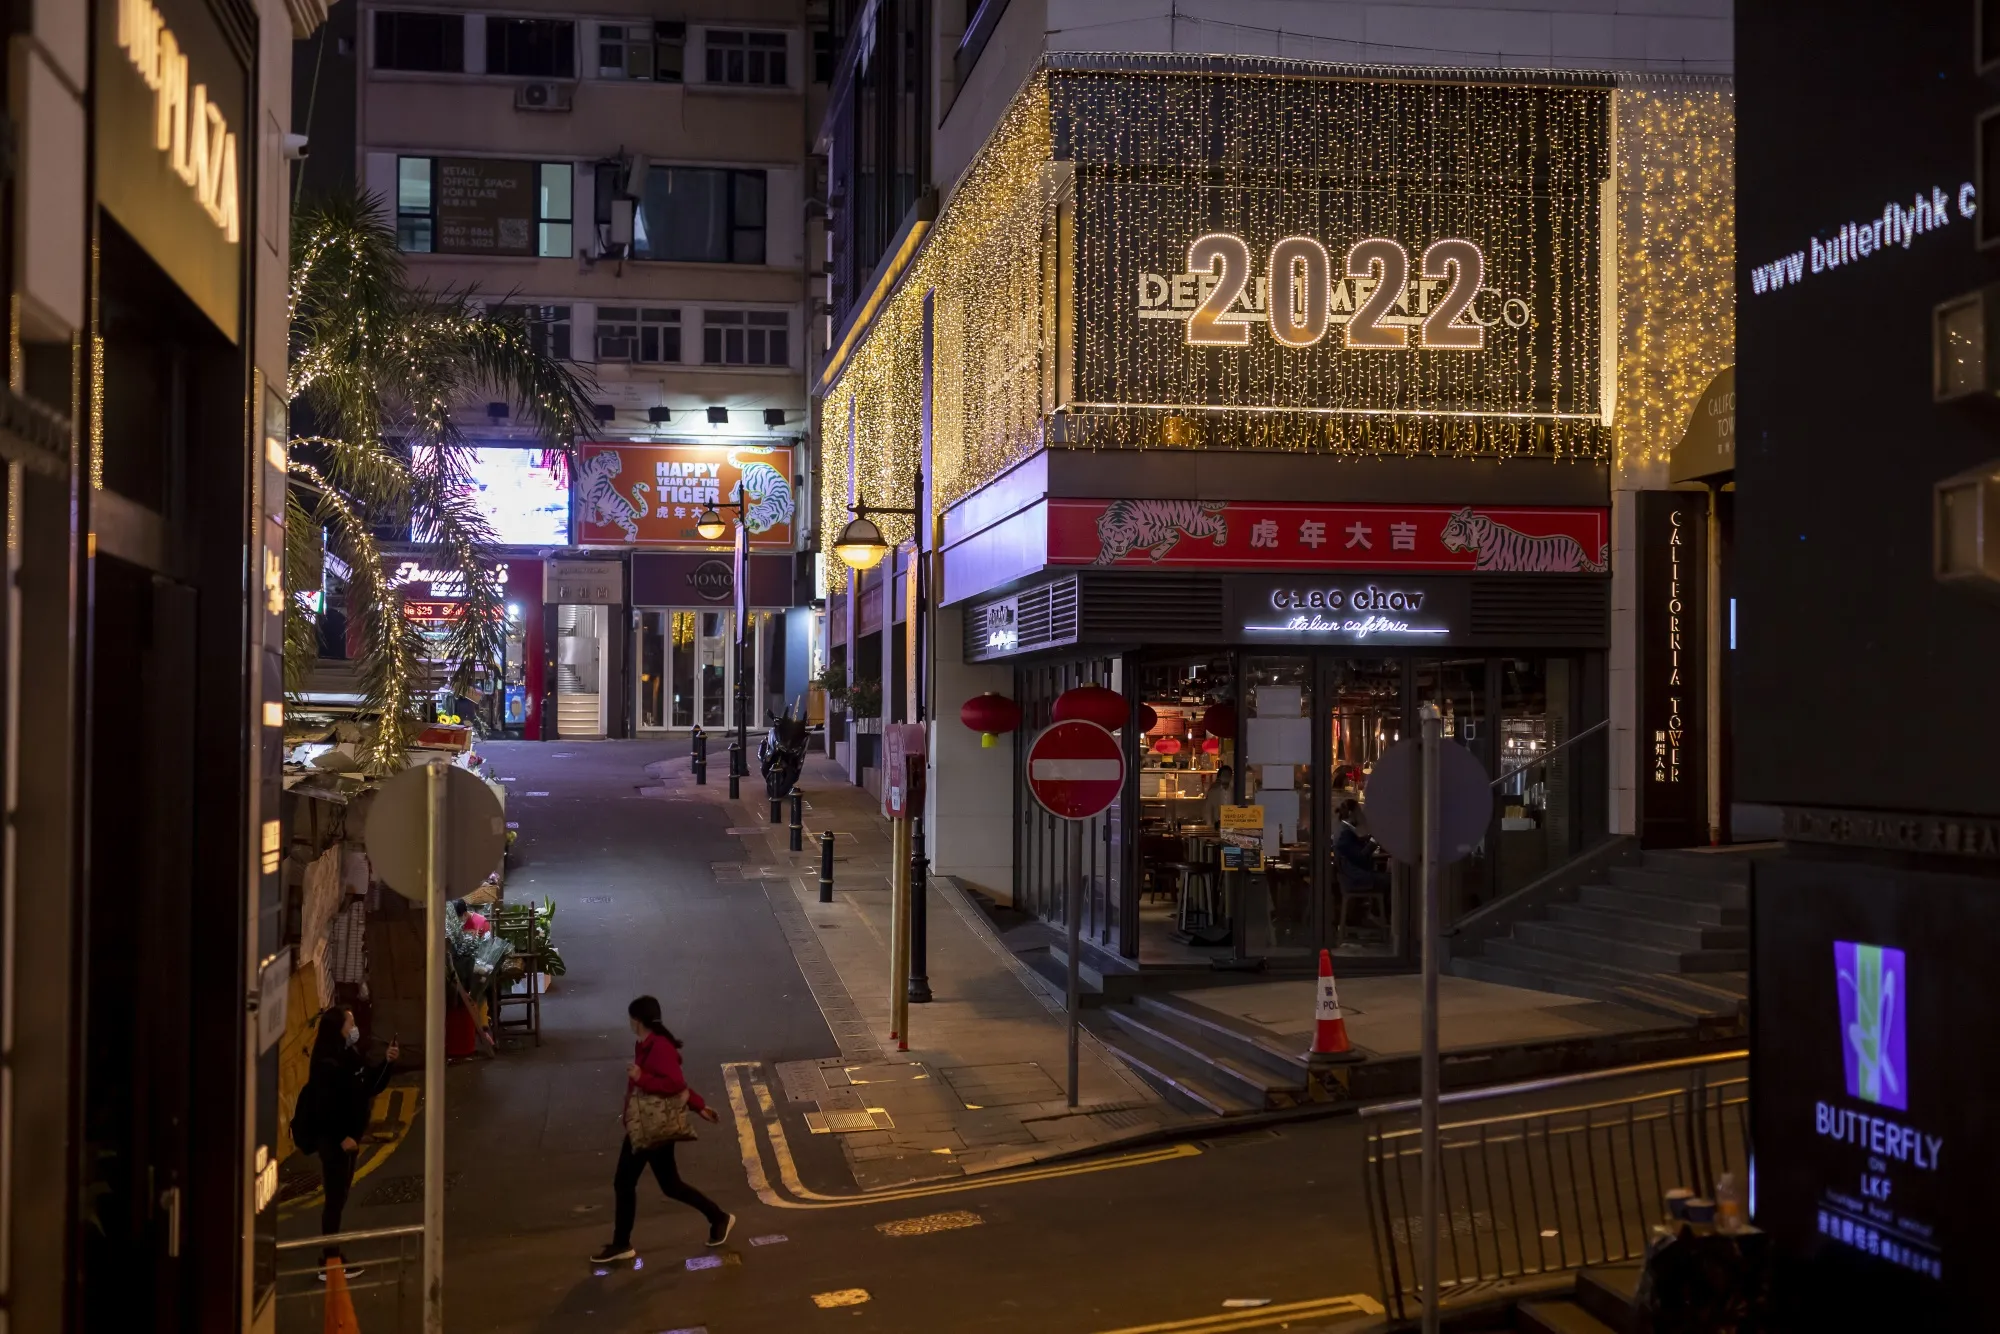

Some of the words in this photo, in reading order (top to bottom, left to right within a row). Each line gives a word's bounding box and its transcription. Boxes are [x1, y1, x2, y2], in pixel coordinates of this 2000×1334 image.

[156, 29, 239, 242] PLAZA
[443, 166, 476, 176] RETAIL
[442, 177, 480, 187] OFFICE
[484, 178, 517, 189] SPACE
[442, 187, 463, 197] FOR
[467, 189, 498, 199] LEASE
[1751, 250, 1805, 295] www
[1810, 185, 1949, 274] butterflyhk
[1186, 232, 1486, 350] 2022
[656, 461, 721, 478] HAPPY
[656, 477, 683, 486] YEAR
[685, 478, 699, 487] OF
[700, 478, 720, 487] THE
[656, 486, 720, 504] TIGER
[656, 506, 720, 520] 虎年大
[1250, 518, 1418, 551] 虎年大吉
[686, 573, 733, 587] MOMO
[1353, 585, 1424, 611] chow
[1669, 510, 1682, 686] CALIFORNIA
[416, 606, 433, 616] $25
[1288, 614, 1340, 632] italian
[1668, 697, 1683, 782] TOWER
[1815, 1101, 1944, 1171] BUTTERFLY
[1860, 1173, 1892, 1201] LKF
